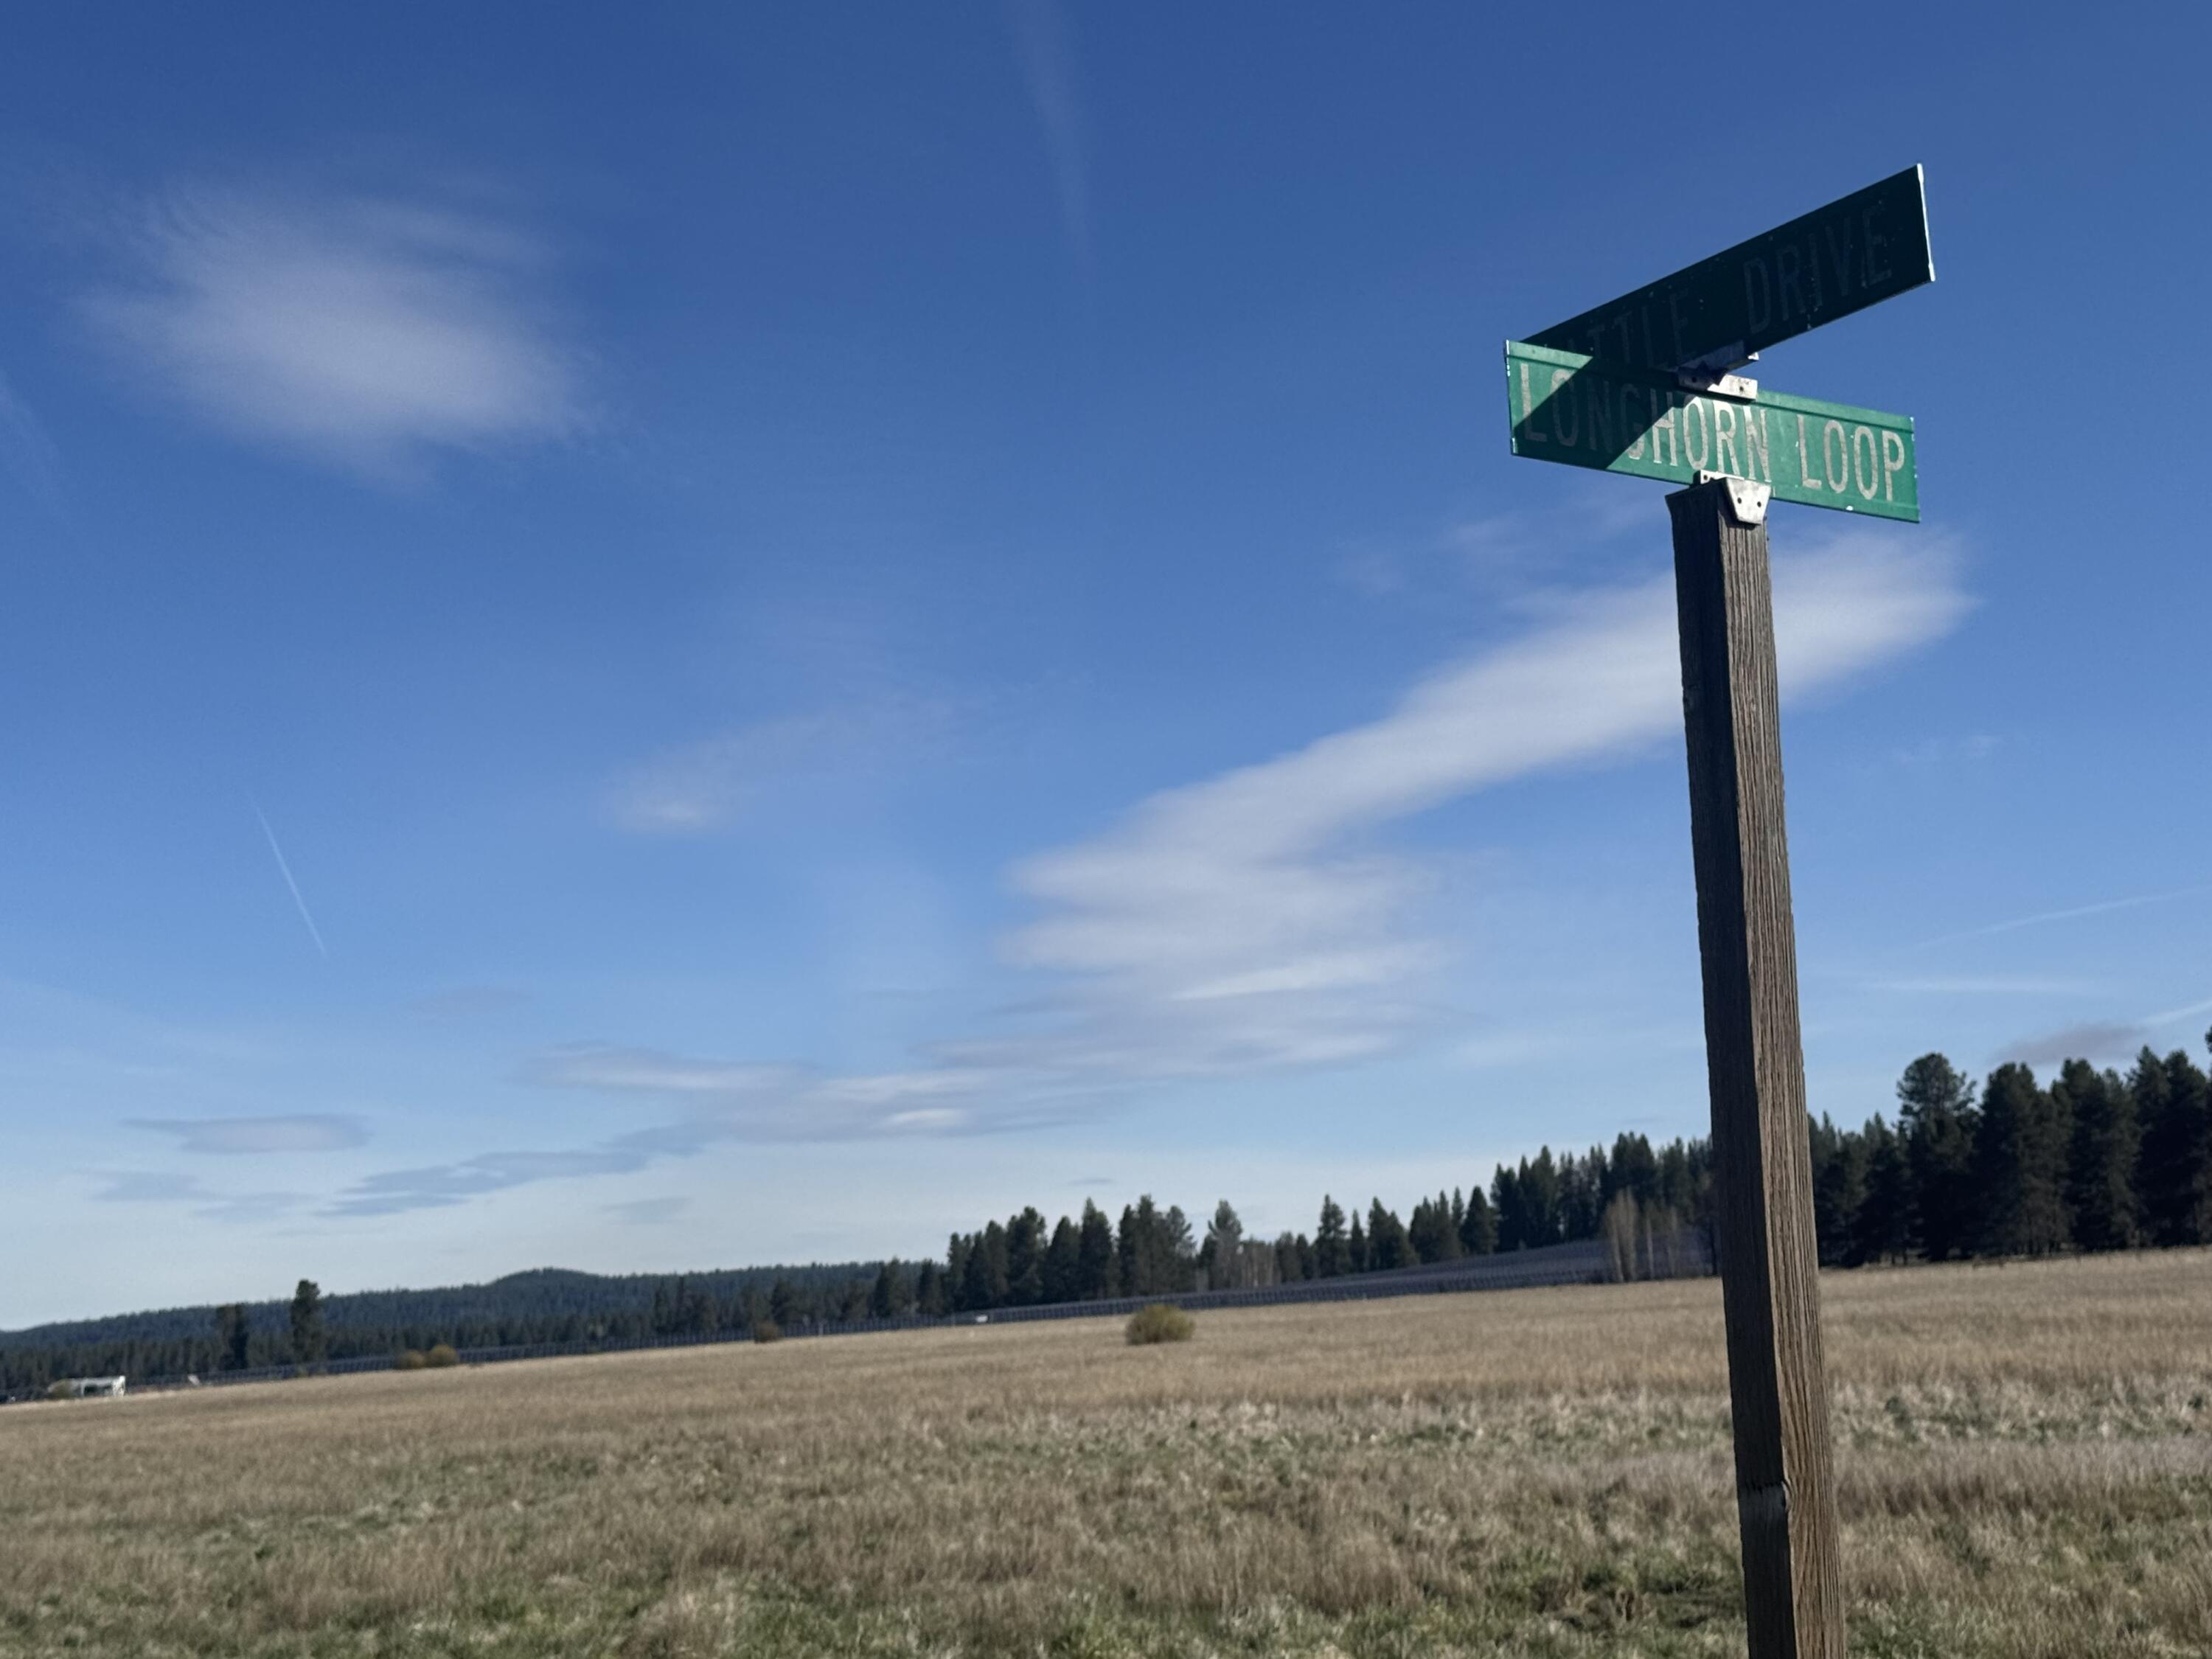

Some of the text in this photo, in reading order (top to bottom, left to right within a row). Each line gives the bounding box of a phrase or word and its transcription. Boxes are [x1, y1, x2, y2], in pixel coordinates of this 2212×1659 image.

[1742, 204, 1893, 335] DRIVE
[1520, 364, 1905, 501] LONGHORN LOOP
